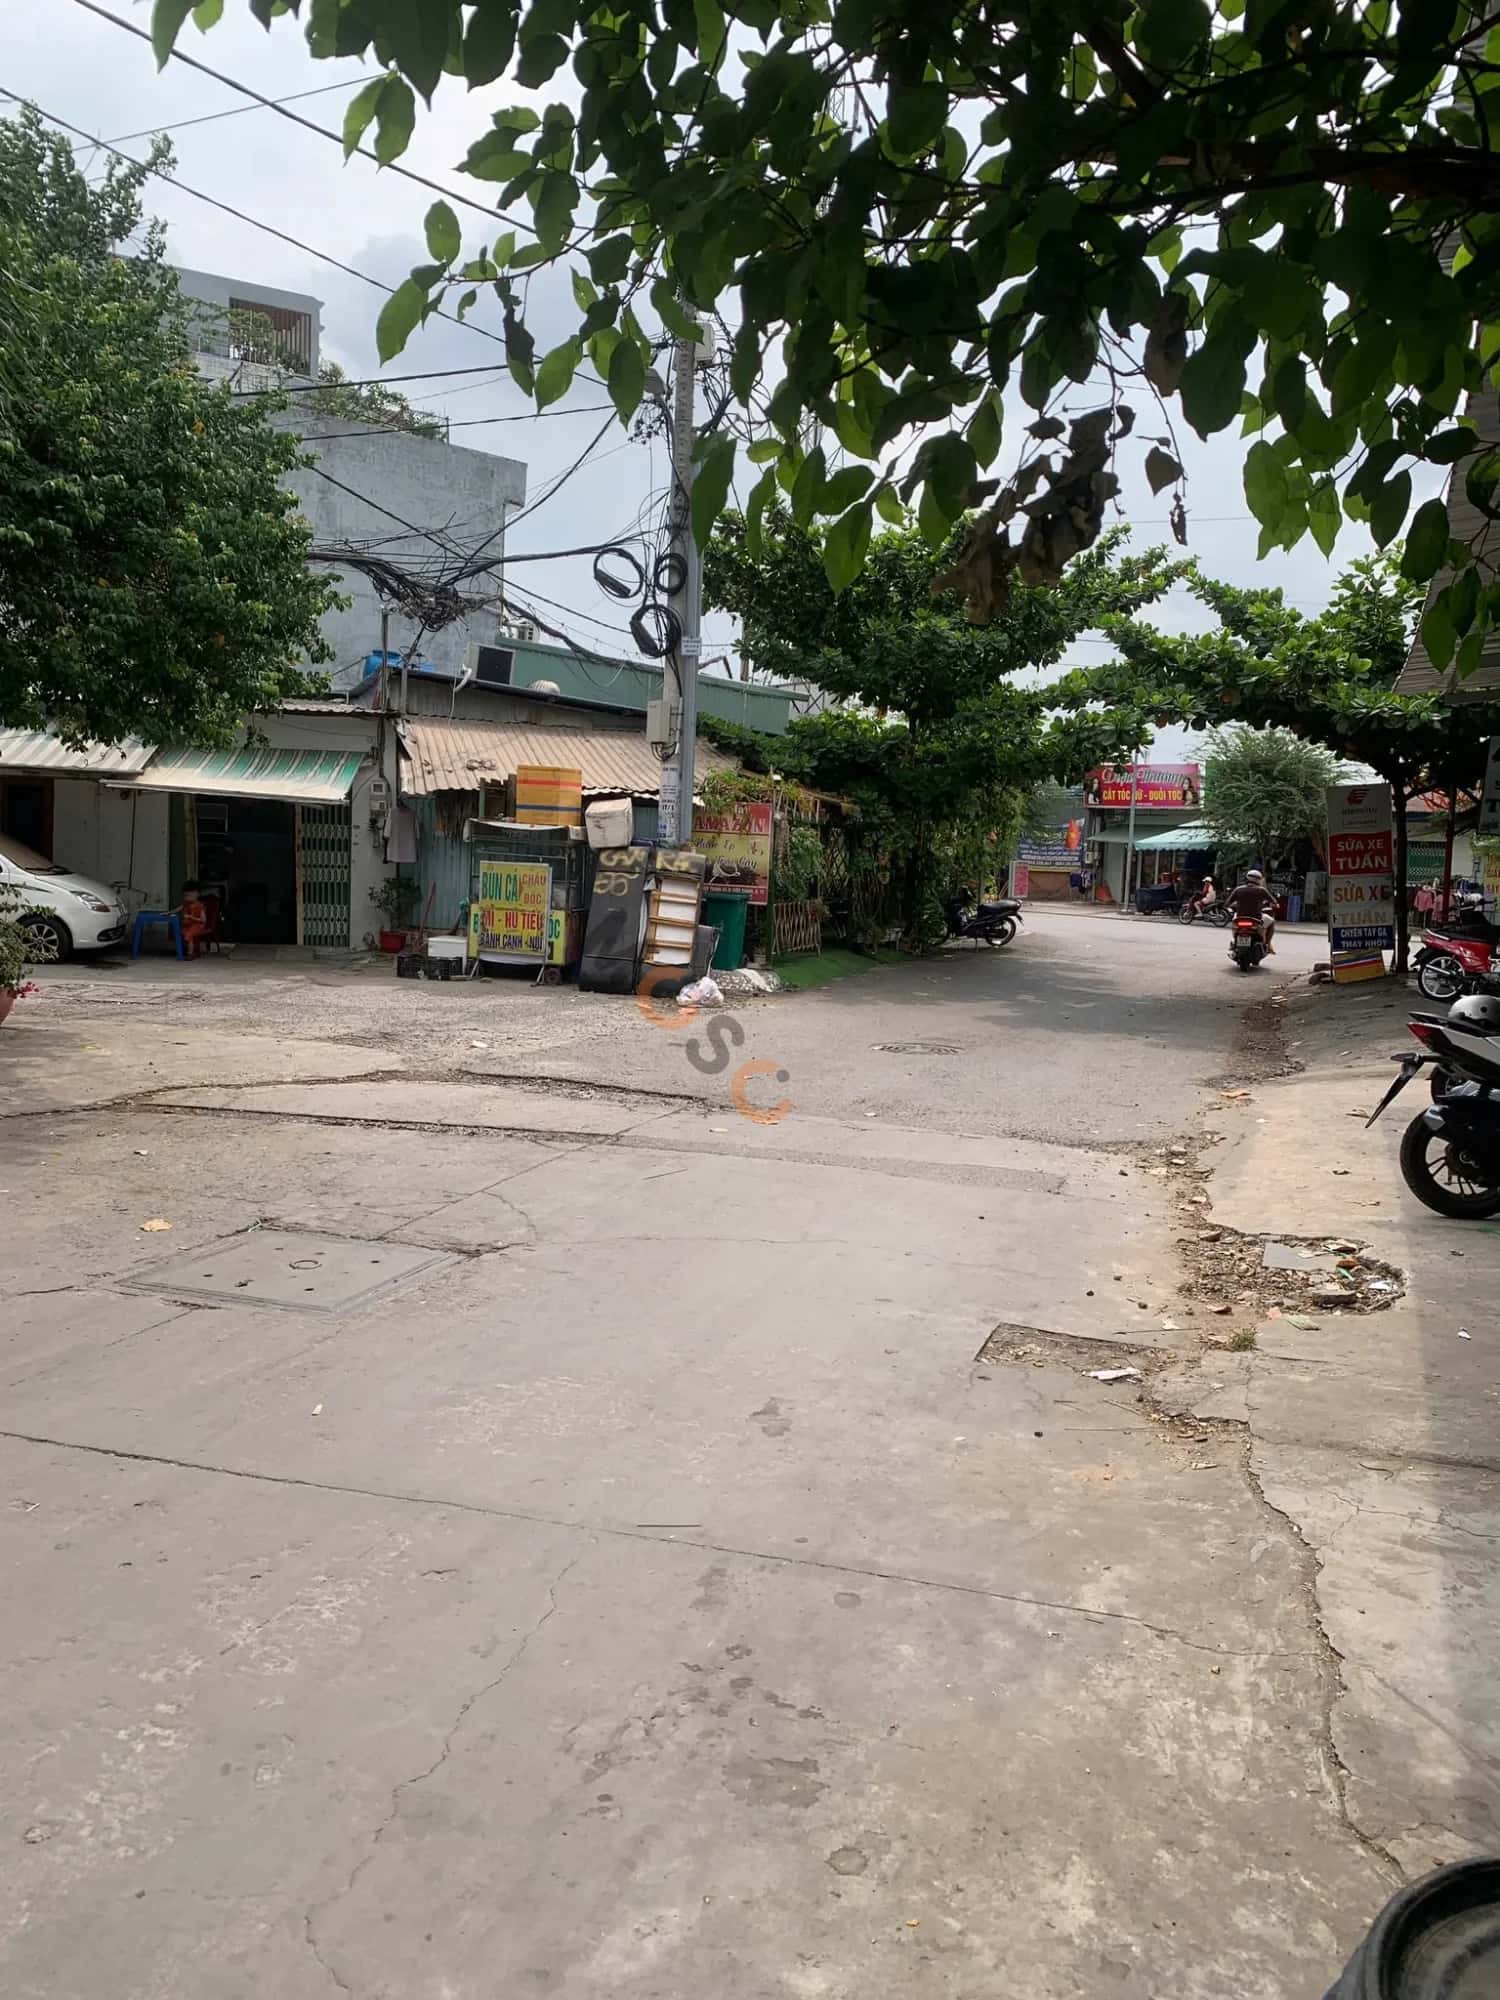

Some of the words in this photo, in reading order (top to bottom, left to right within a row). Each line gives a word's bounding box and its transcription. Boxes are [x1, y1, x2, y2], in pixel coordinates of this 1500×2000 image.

[1368, 838, 1384, 851] XE
[1334, 880, 1365, 903] SỬA
[1369, 884, 1390, 901] XE
